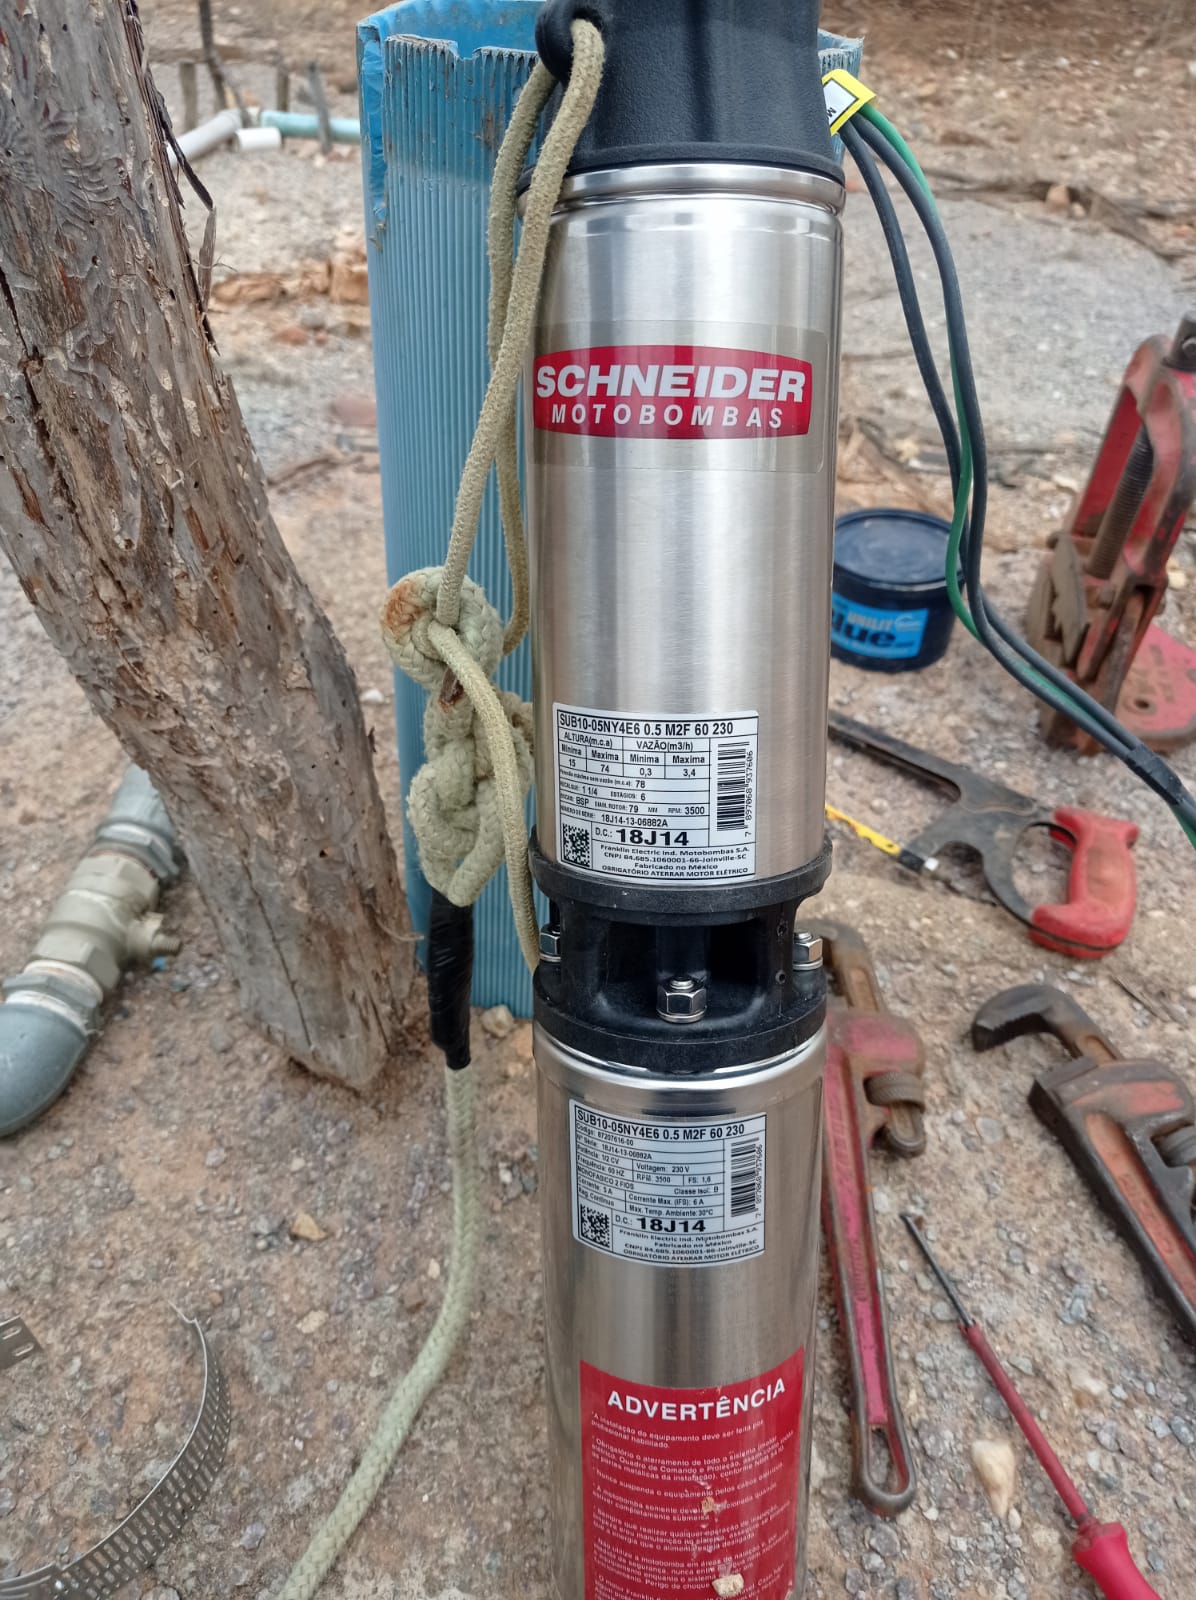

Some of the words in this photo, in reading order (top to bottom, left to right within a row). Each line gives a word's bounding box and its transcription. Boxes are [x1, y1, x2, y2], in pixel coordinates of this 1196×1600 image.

[536, 365, 806, 402] SCHNEIDER
[551, 403, 783, 429] MOTOBOMBAS
[832, 607, 896, 648] lue
[560, 713, 640, 735] SUB10-05NY4E6
[644, 723, 661, 736] 0.5
[665, 724, 691, 736] M2F
[694, 723, 709, 736] 60
[712, 722, 733, 735] 230
[636, 740, 693, 752] VAZÃO(m3/h)
[569, 758, 576, 767] 15
[672, 755, 705, 763] Maxima
[600, 764, 610, 773] 74
[639, 768, 652, 778] 0,3
[683, 768, 696, 778] 3,4
[635, 780, 646, 789] 78
[588, 788, 598, 796] 1/4
[641, 793, 646, 801] 6
[576, 797, 589, 806] BSP
[629, 805, 639, 813] 79
[685, 806, 705, 814] 3500
[602, 814, 668, 827] 18J14-13-06882A
[595, 827, 613, 838] D.C.:
[616, 829, 689, 846] 18J14
[600, 844, 630, 853] Franklin
[680, 848, 734, 856] Motobombas
[602, 864, 649, 876] OBRIGATÓRIO
[716, 867, 749, 876] ELÉTRICO
[577, 1109, 660, 1139] SUB10-05NY4E6
[663, 1129, 680, 1140] 0.5
[683, 1129, 706, 1141] M2F
[710, 1127, 723, 1139] 60
[726, 1124, 745, 1137] 230
[615, 1215, 632, 1225] D.C.:
[636, 1217, 706, 1233] 18J14
[608, 1378, 786, 1421] ADVERTÊNCIA
[649, 1432, 700, 1442] equipamento
[702, 1433, 720, 1441] deve
[660, 1465, 697, 1474] Comando
